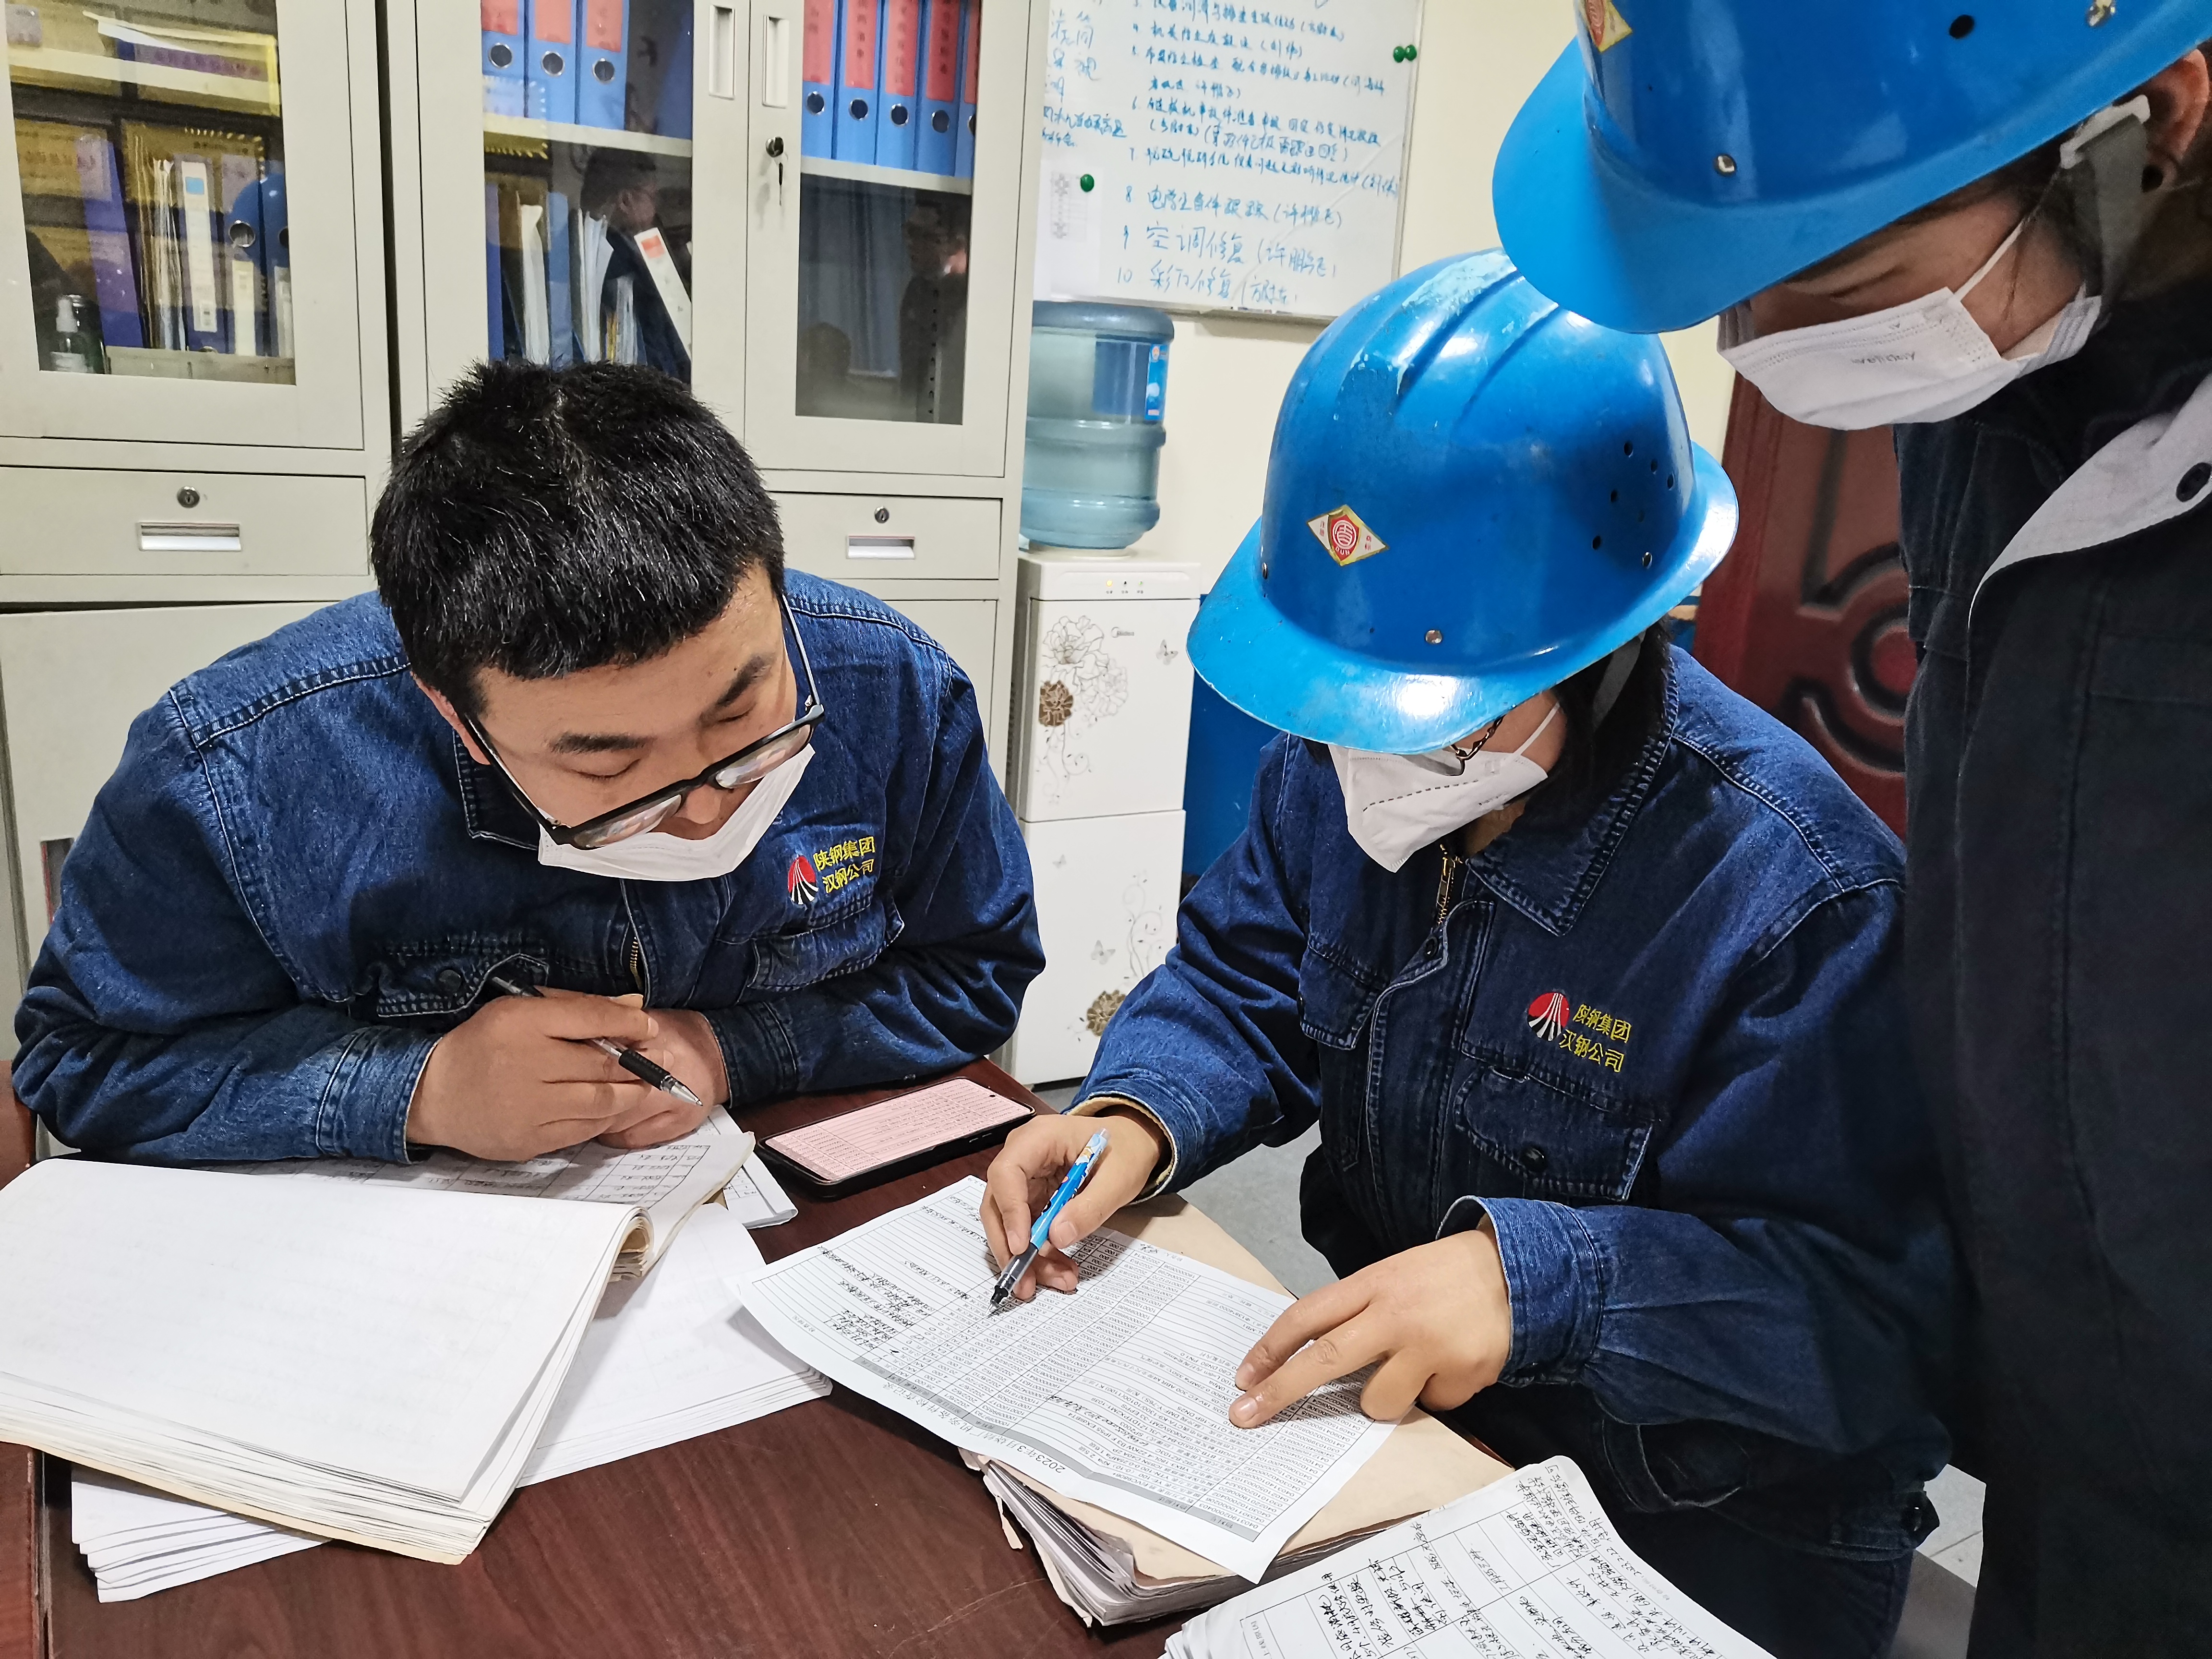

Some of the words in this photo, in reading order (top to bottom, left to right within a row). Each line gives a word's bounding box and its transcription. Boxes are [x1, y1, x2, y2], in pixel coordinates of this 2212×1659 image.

[813, 836, 876, 872] 陕钢集团
[822, 859, 875, 894] 汉钢公司
[1573, 1003, 1632, 1044] 陕钢集团
[1558, 1029, 1625, 1072] 汉钢公司
[941, 1393, 971, 1408] 2022/6/1
[1094, 1427, 1112, 1437] IP55
